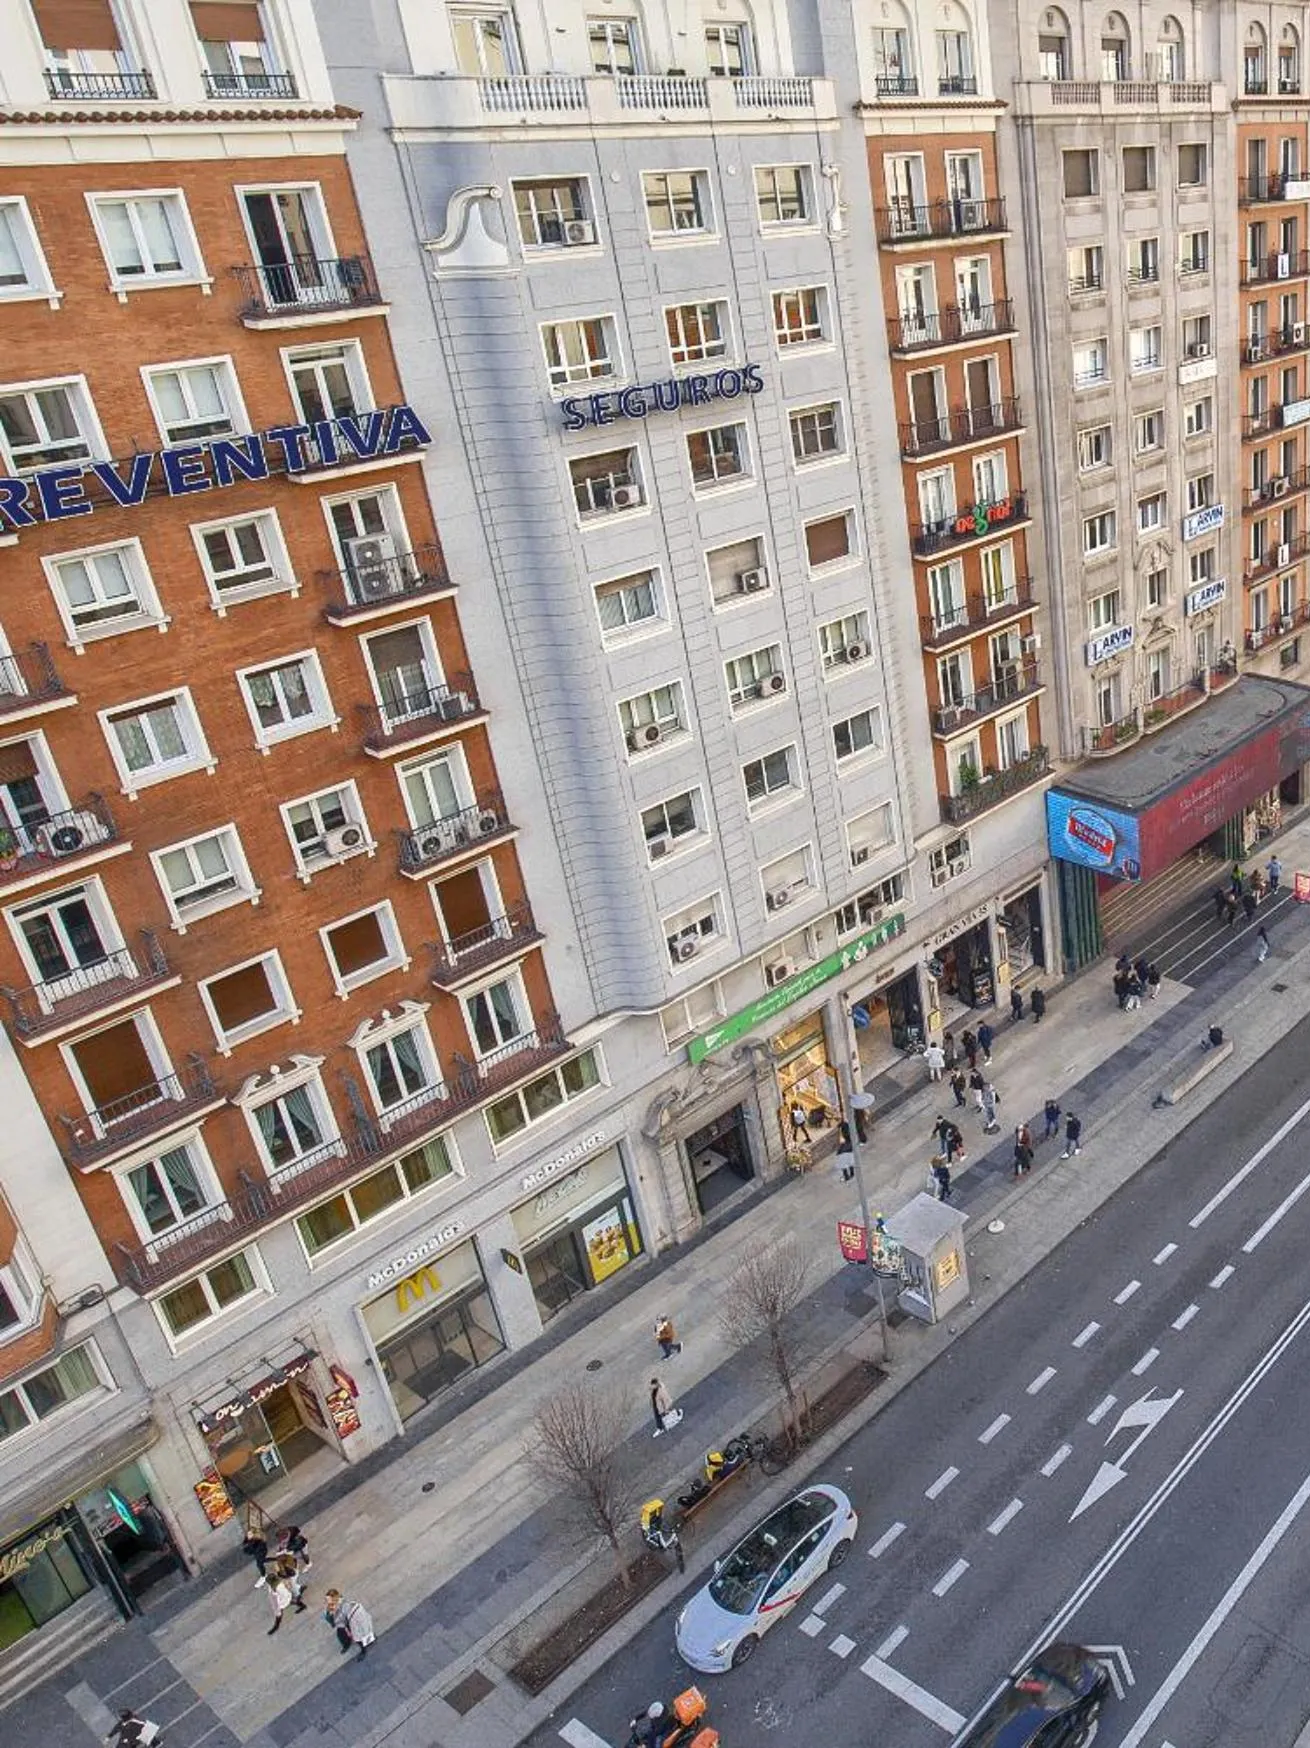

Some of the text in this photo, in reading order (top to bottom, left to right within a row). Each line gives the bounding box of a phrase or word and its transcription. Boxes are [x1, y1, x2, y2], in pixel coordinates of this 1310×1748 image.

[562, 363, 764, 431] SEGUROS
[0, 407, 431, 532] REVENTIVA
[1092, 626, 1133, 661] LARVIN
